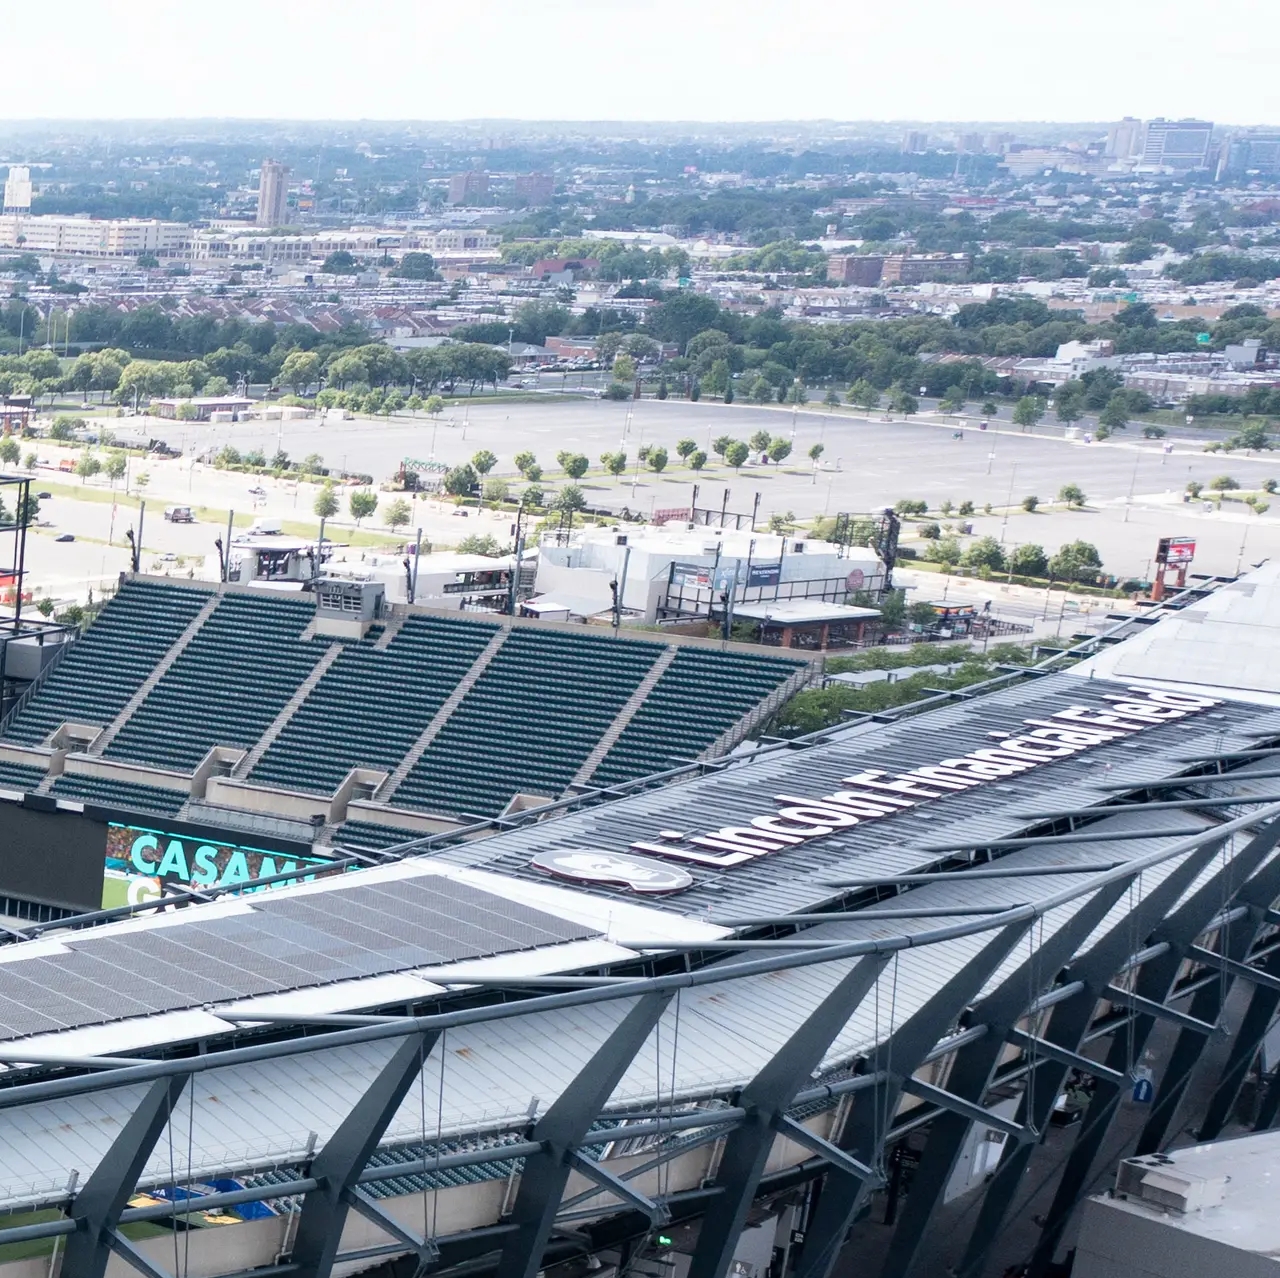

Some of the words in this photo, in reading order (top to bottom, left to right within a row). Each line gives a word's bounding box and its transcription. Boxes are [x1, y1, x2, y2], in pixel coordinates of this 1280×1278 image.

[630, 791, 915, 868] Lincoln
[842, 720, 1124, 798] Financial
[1053, 686, 1225, 730] Field
